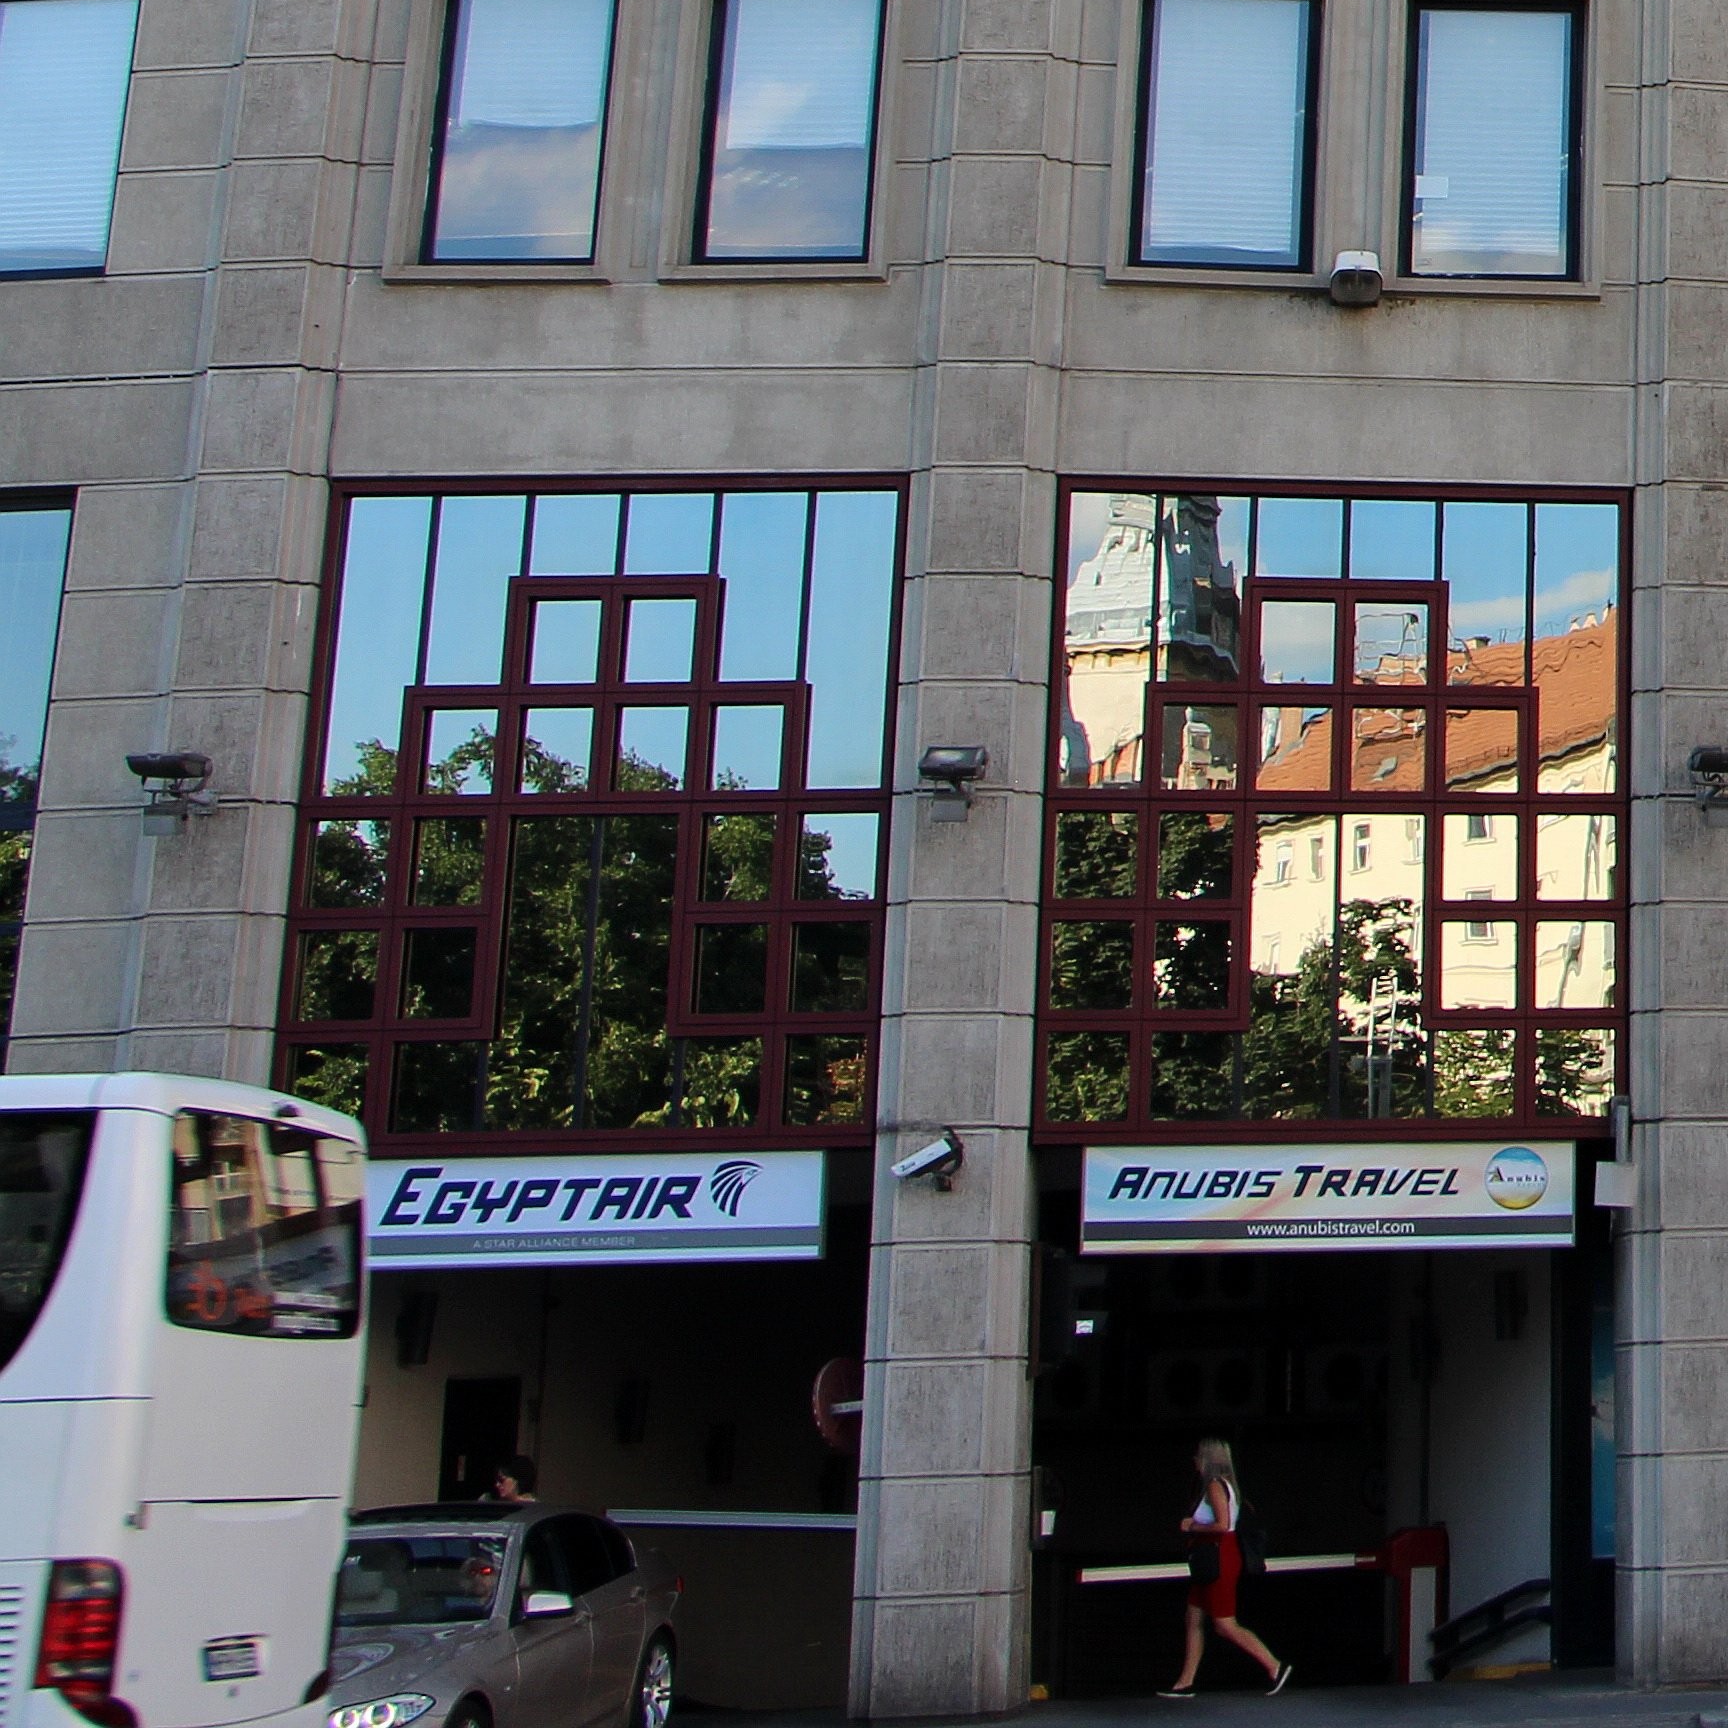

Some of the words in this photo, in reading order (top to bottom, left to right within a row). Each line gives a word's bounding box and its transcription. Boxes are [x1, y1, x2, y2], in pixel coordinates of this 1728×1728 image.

[1108, 1165, 1283, 1200] ANUBIS
[1292, 1164, 1460, 1198] TRAVEL
[378, 1166, 704, 1226] EGYPTAIR
[1246, 1219, 1416, 1237] www.anubistravel.com
[484, 1238, 516, 1250] STAR
[517, 1236, 578, 1249] ALLIANCE
[581, 1236, 636, 1247] MEMBER
